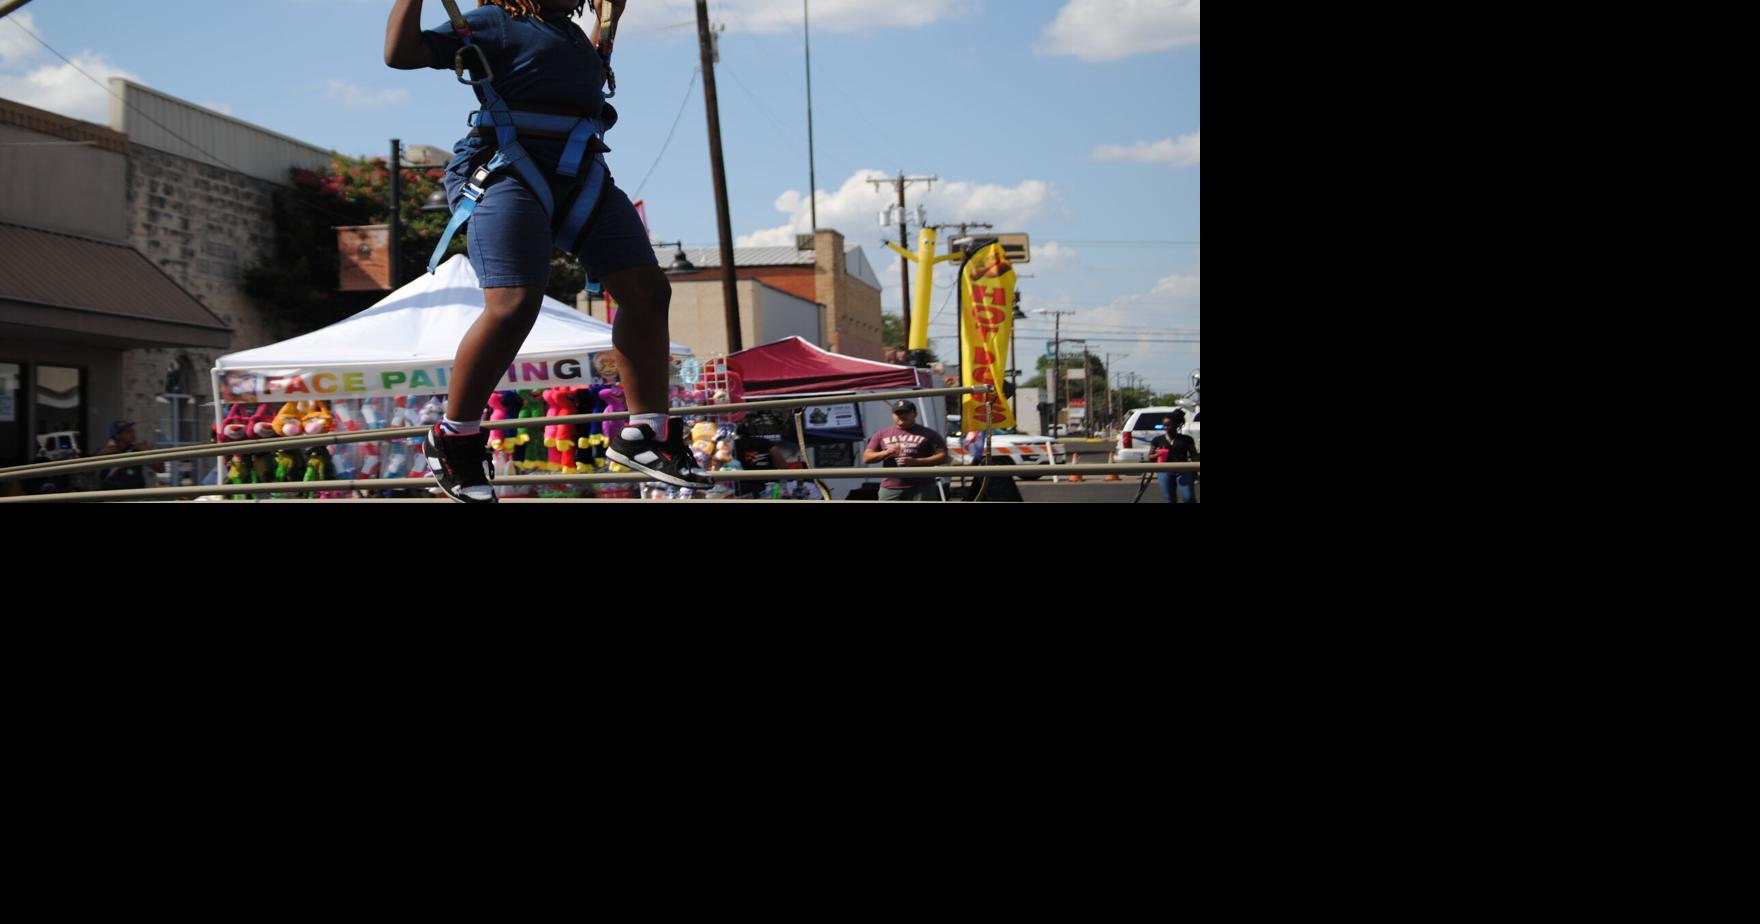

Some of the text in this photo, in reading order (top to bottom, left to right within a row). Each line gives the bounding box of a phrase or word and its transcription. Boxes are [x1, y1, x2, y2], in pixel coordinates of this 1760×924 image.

[971, 285, 1007, 344] HOT
[263, 358, 582, 395] FACE PAIING
